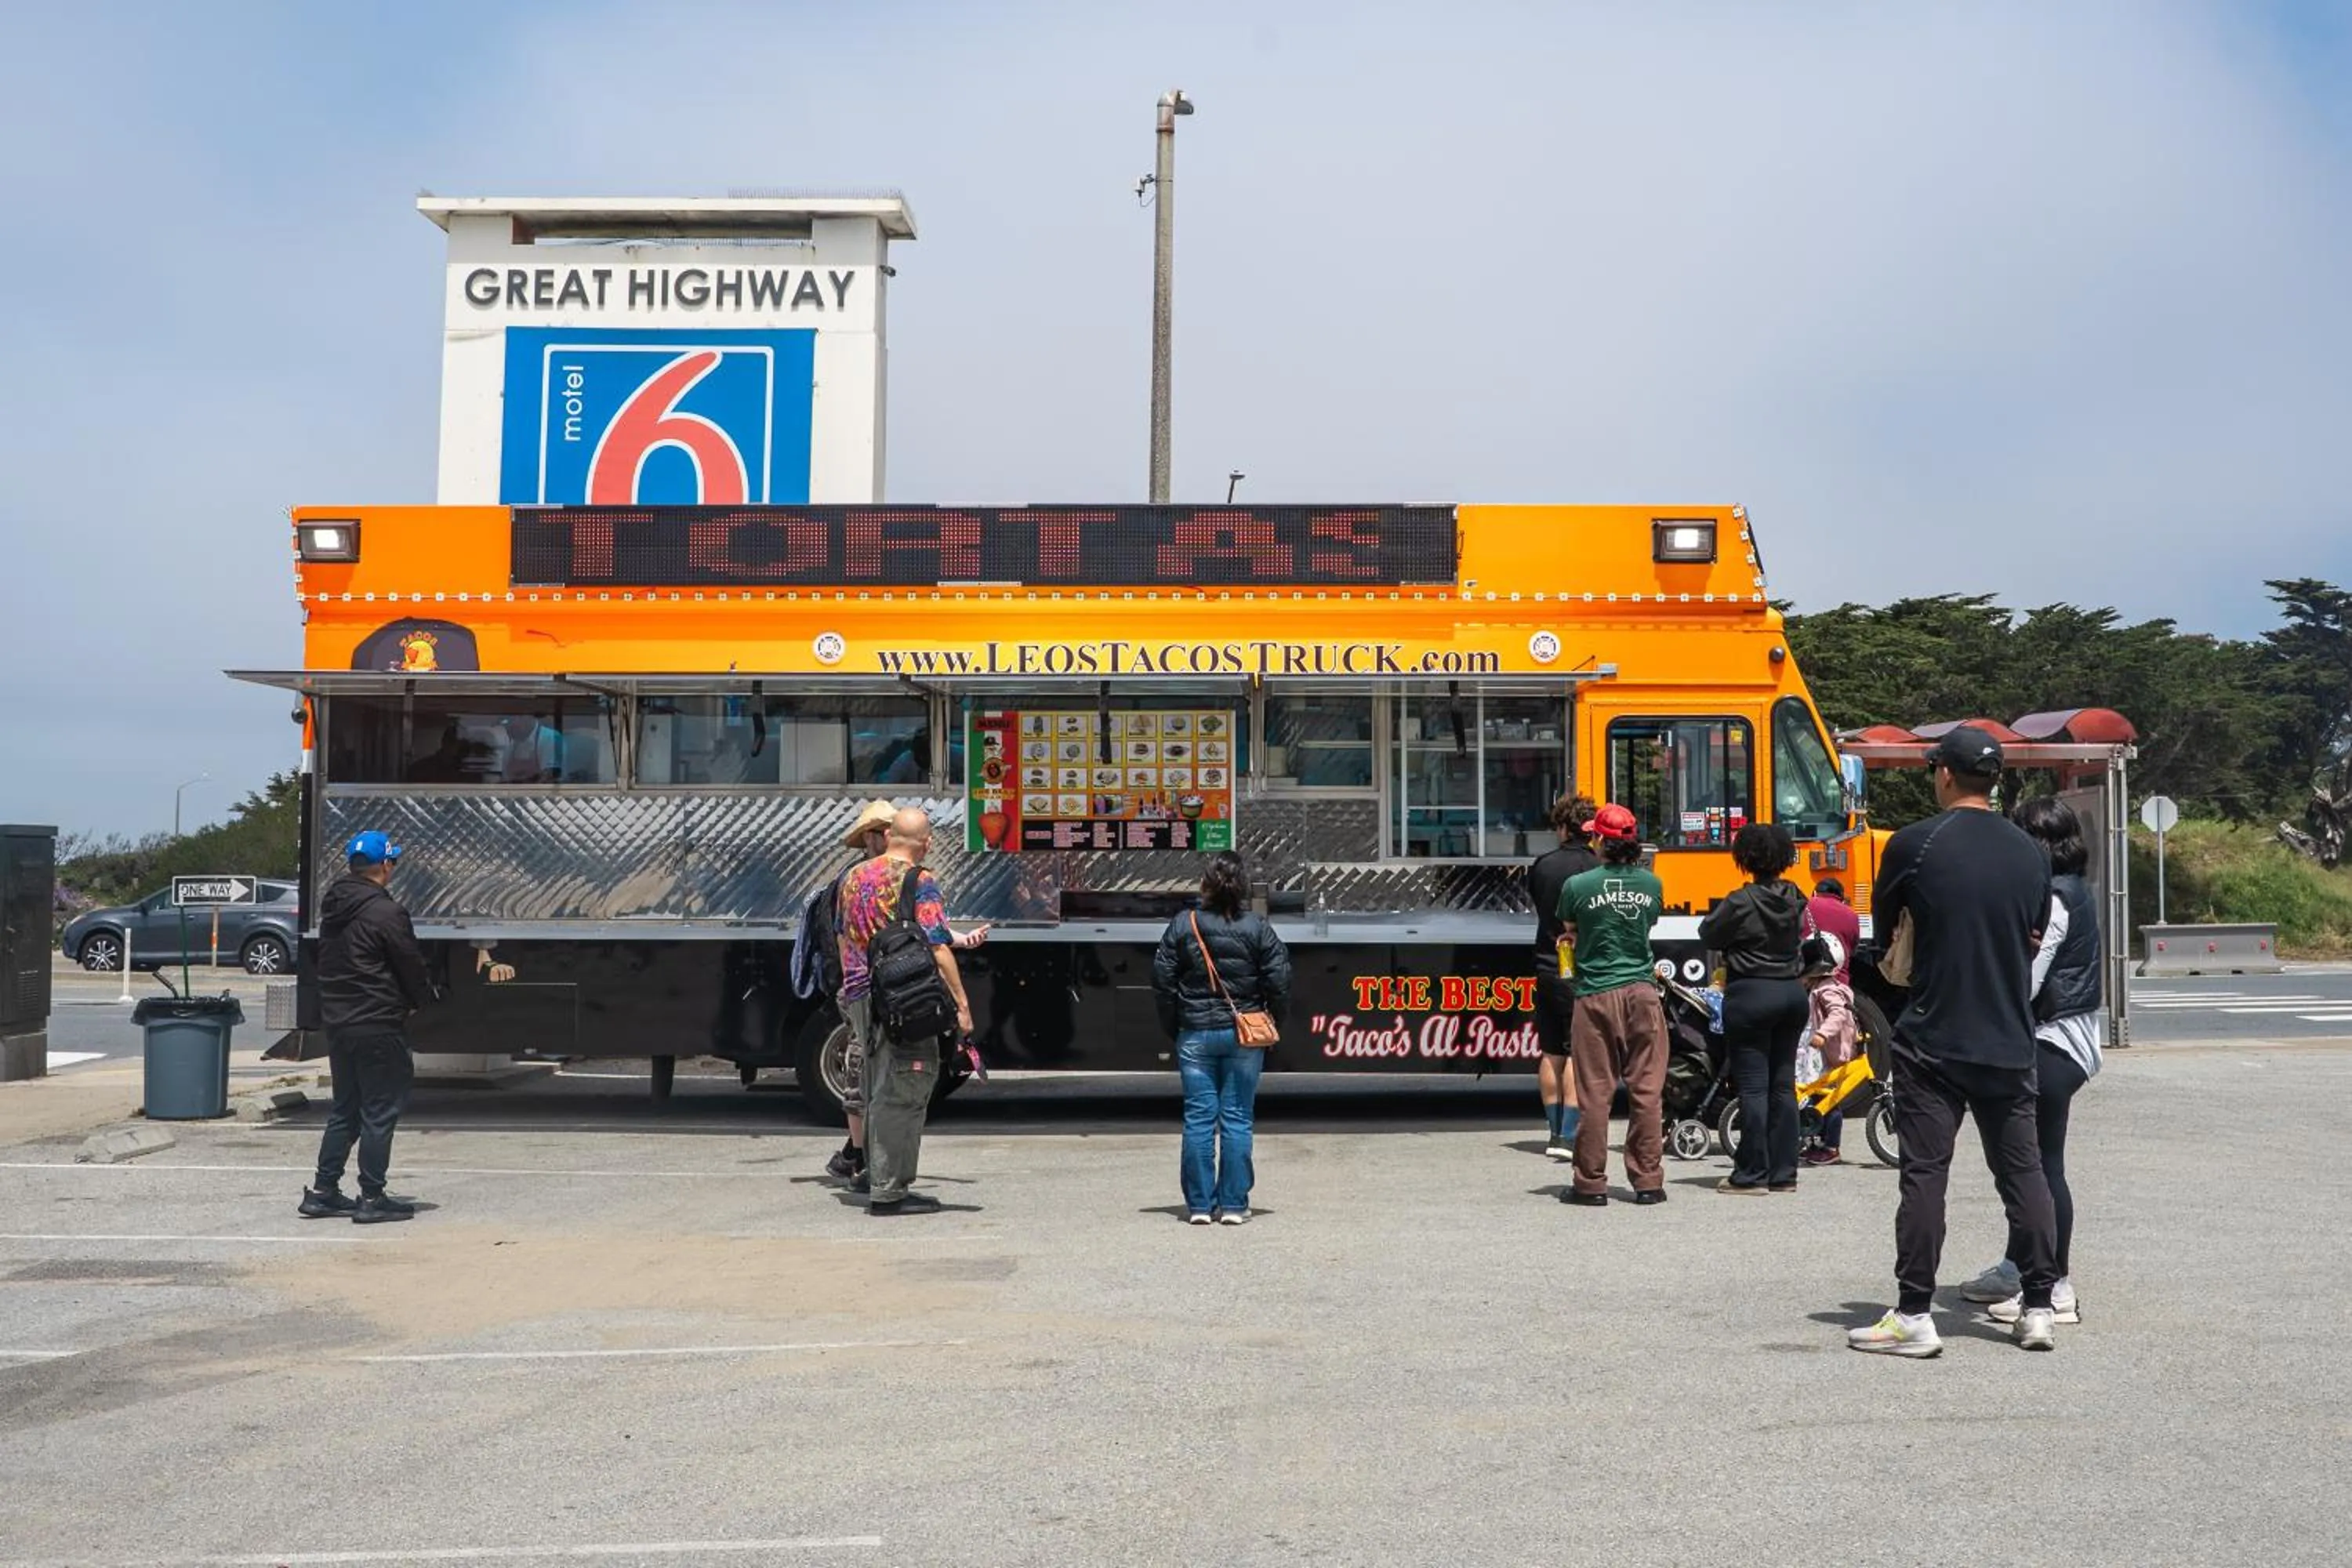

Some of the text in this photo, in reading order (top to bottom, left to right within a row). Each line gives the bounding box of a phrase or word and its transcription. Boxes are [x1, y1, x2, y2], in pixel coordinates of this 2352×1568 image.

[465, 268, 855, 310] GREAT HIGHWAY
[563, 365, 584, 441] motel
[584, 350, 750, 504] 6
[539, 513, 1379, 576] TORTAS
[181, 884, 232, 896] ONE WAY
[1589, 891, 1652, 909] JAMESON
[1353, 977, 1537, 1011] THE BEST
[1419, 1014, 1461, 1058] Al
